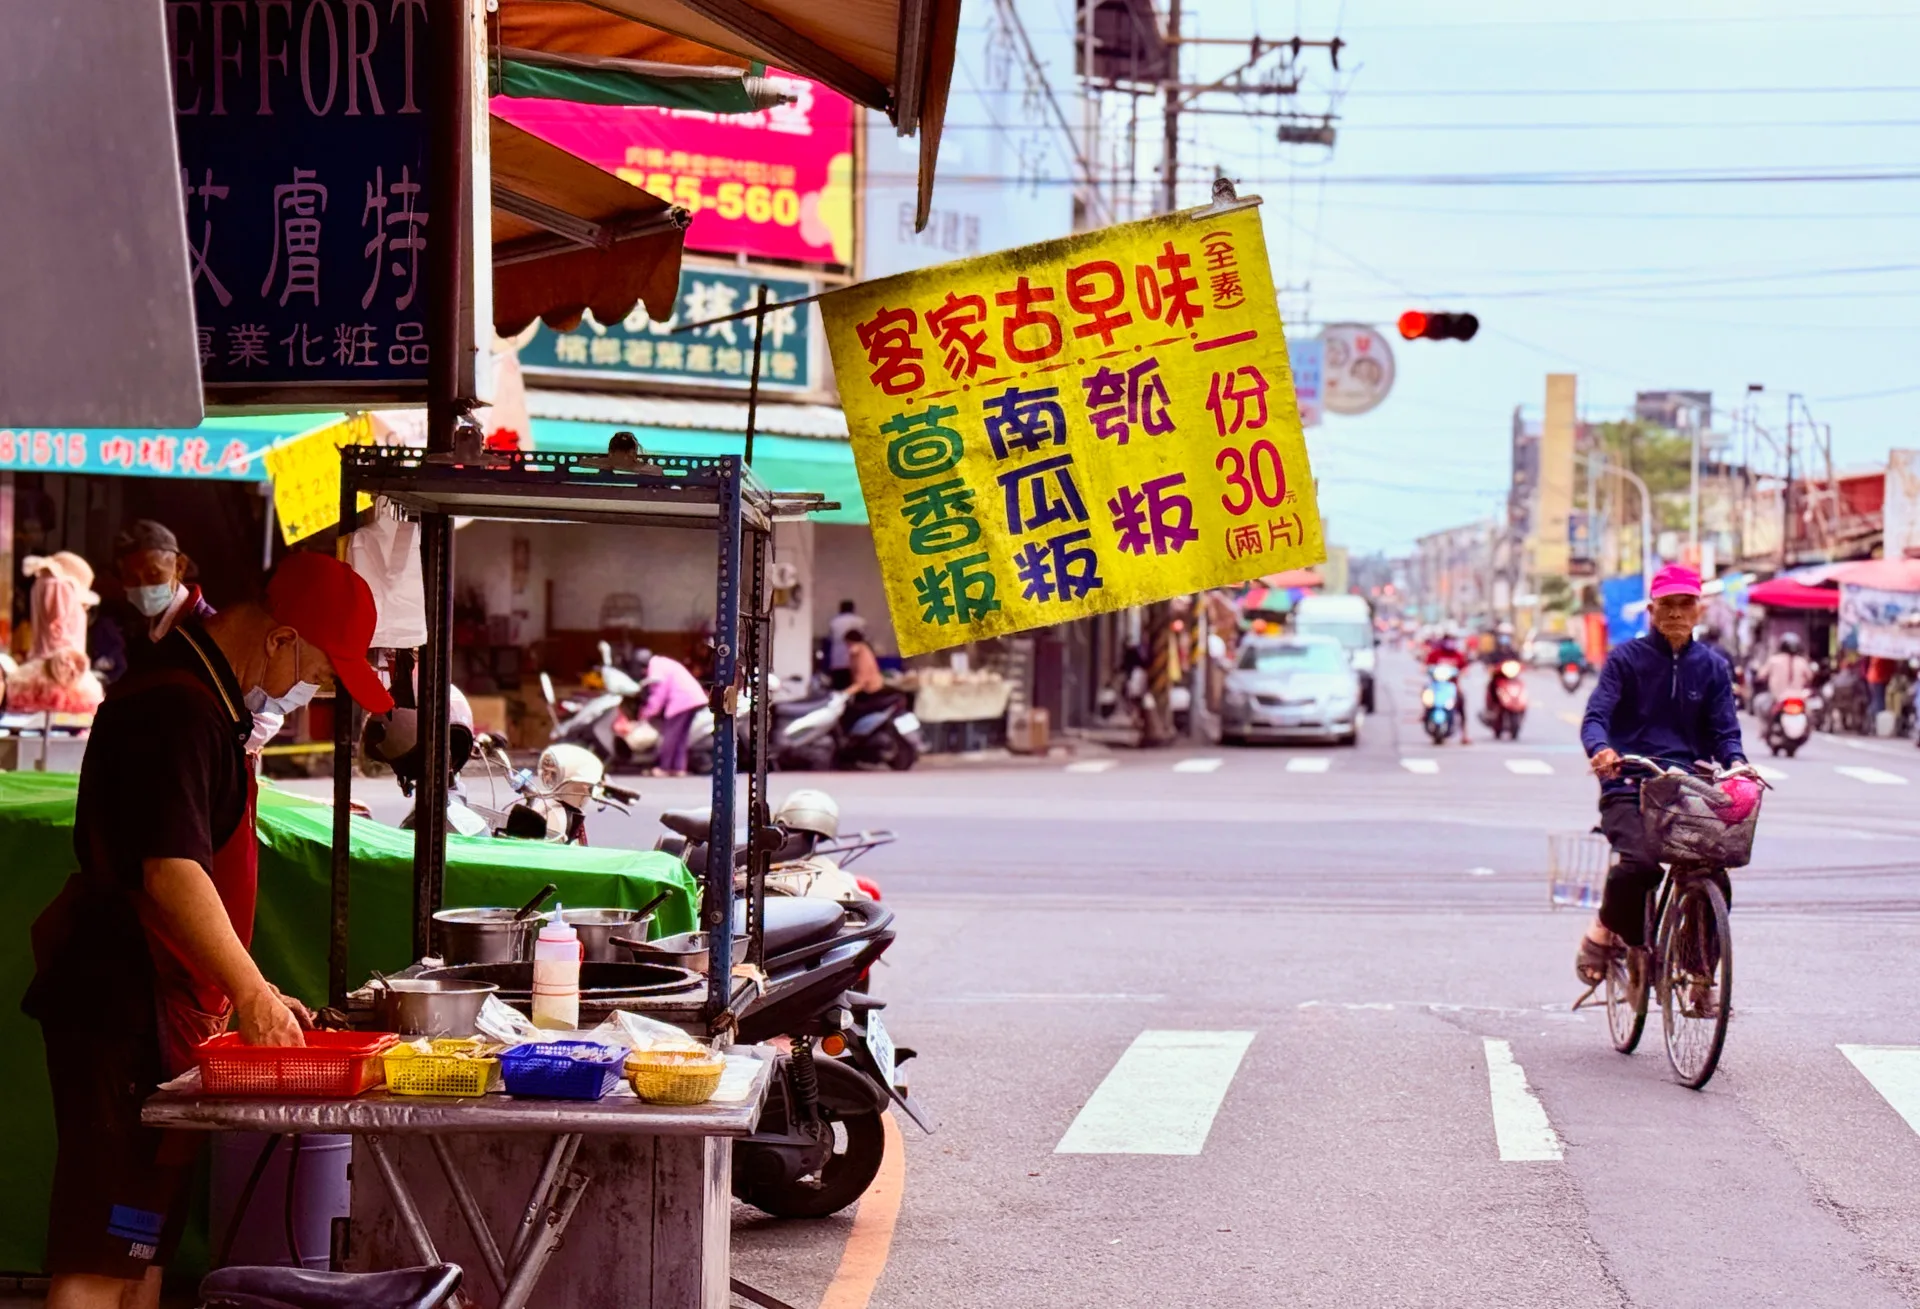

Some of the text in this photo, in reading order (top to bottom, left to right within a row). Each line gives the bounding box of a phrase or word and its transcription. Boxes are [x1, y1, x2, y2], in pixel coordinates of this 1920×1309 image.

[168, 0, 428, 117] EFFORT
[856, 241, 1204, 396] 客家古早味
[1200, 231, 1246, 310] (全素)
[880, 405, 1001, 626] 茴香粄
[983, 387, 1103, 602] 南瓜粄
[1225, 513, 1304, 561] (兩片)
